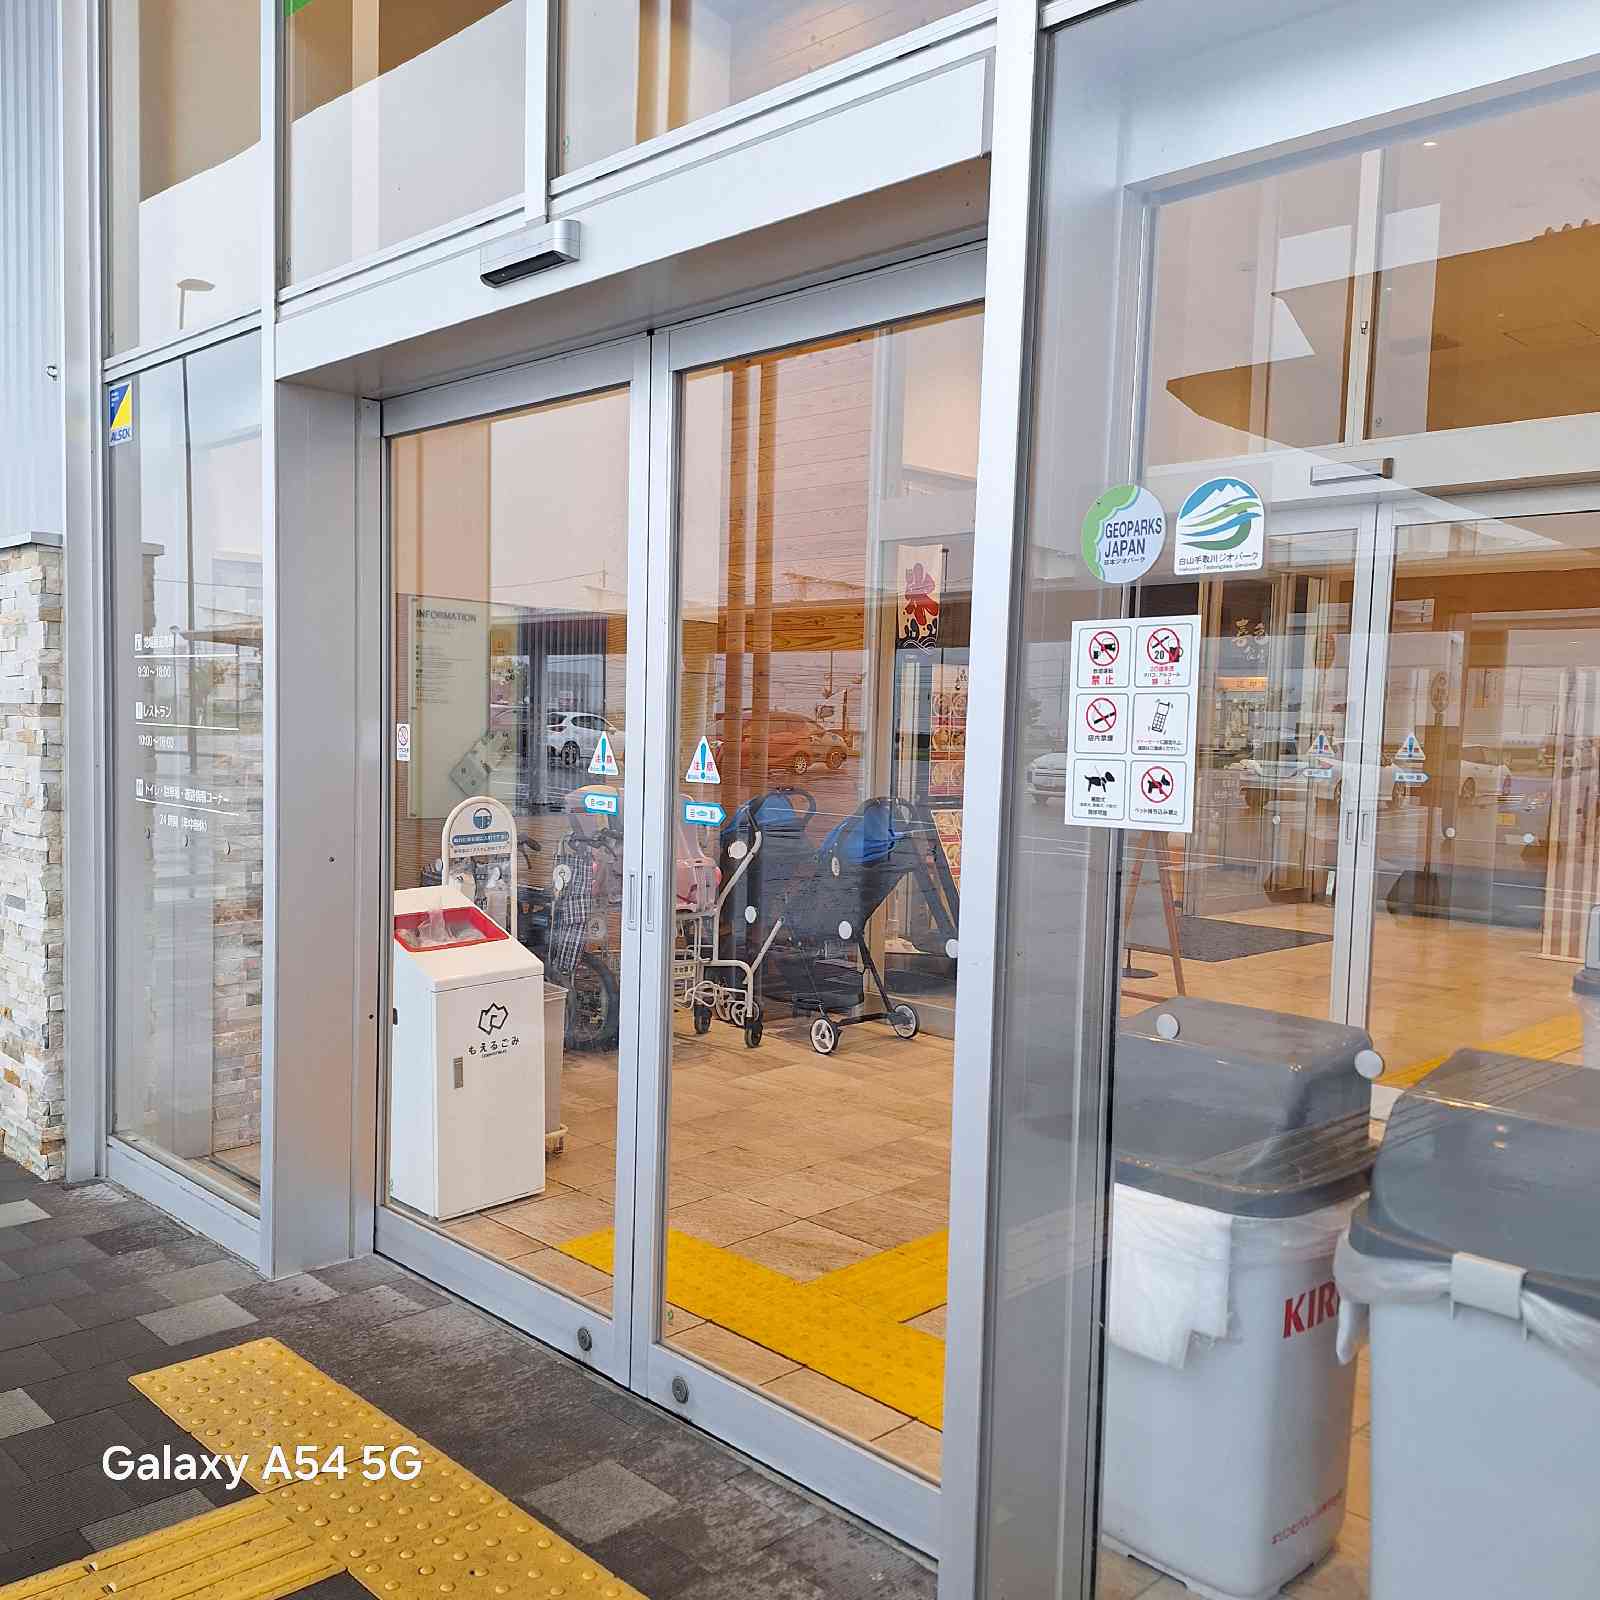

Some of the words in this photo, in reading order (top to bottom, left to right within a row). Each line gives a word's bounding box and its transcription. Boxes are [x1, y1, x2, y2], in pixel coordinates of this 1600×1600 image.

[1105, 517, 1162, 538] GEOPARKS
[1104, 538, 1146, 558] JAPAN
[416, 608, 477, 622] INFORMATION
[143, 703, 172, 718] レストラン
[468, 1035, 520, 1055] もえるごみ
